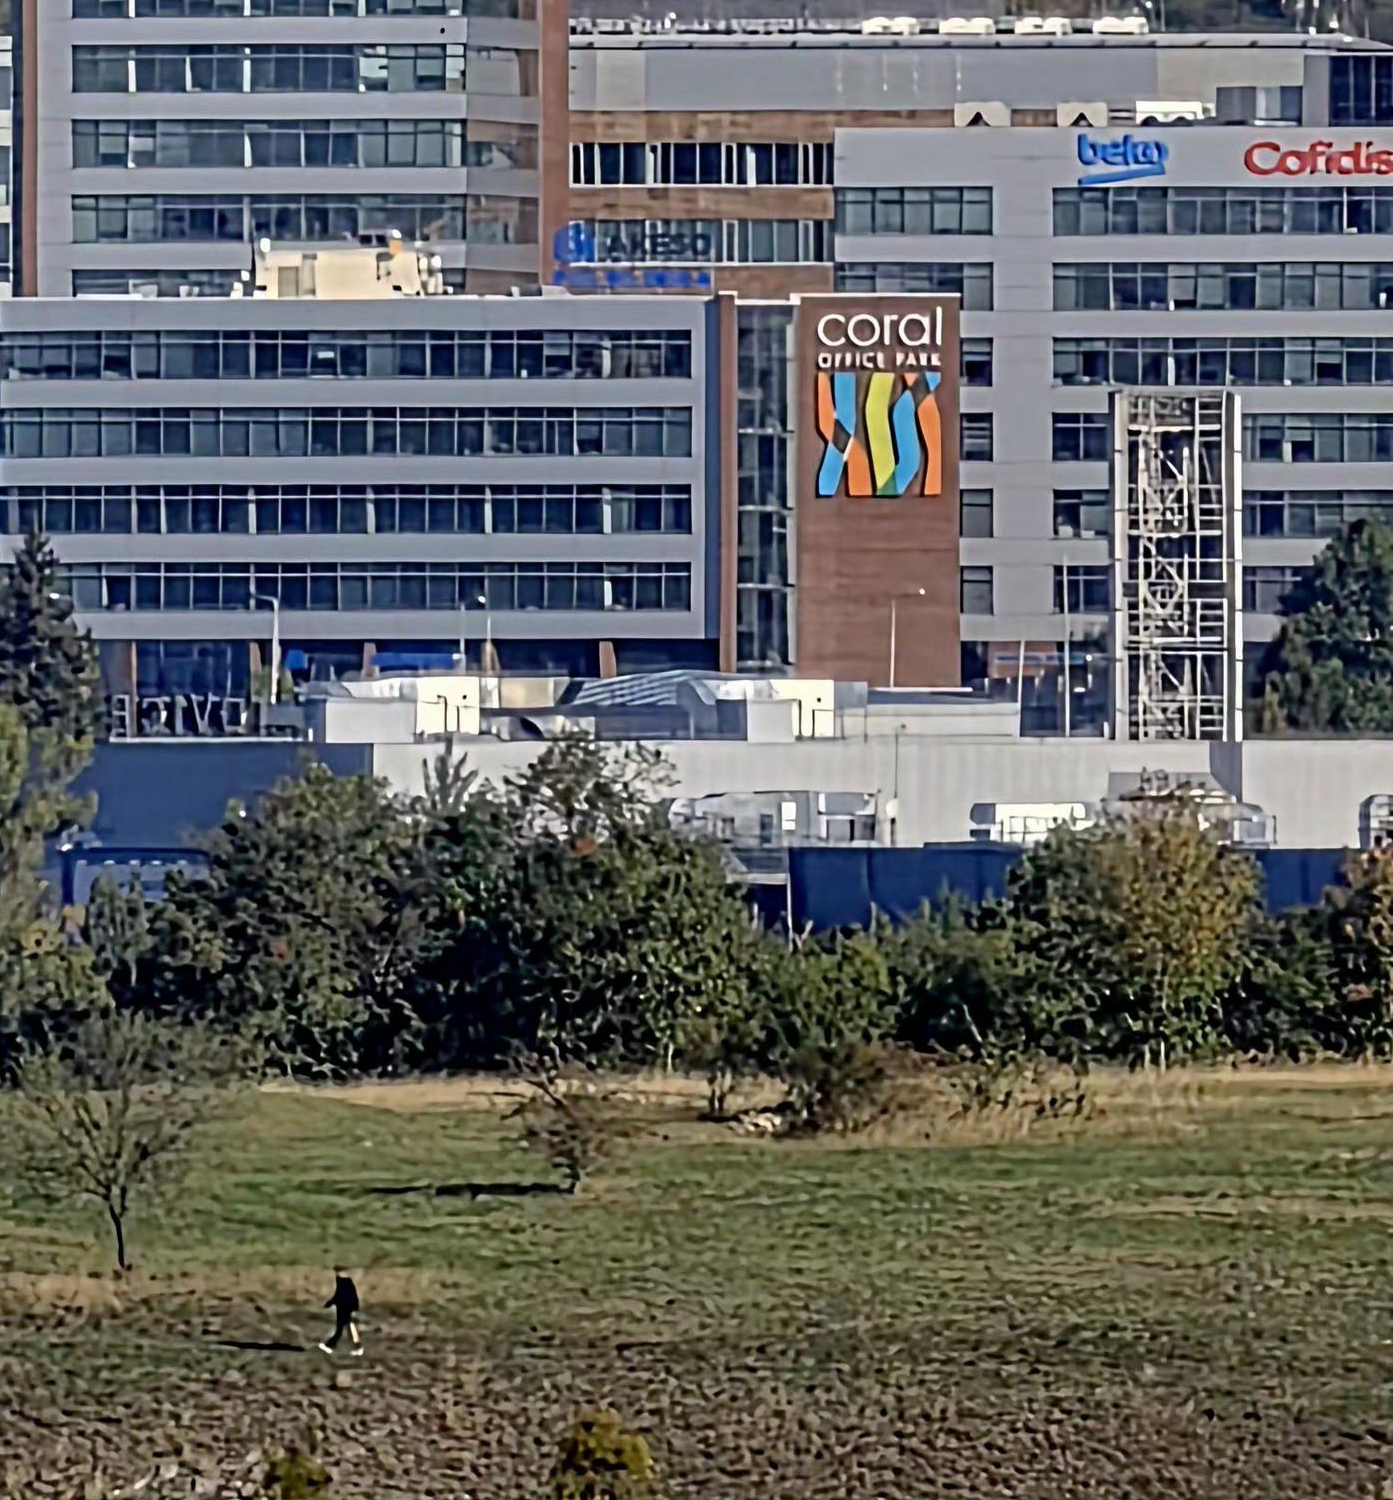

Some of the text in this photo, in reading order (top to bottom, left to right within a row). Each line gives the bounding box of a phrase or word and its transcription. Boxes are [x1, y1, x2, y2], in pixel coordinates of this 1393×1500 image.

[1244, 140, 1393, 175] Cofidis
[817, 306, 943, 346] coral
[818, 352, 942, 369] OFFICE PARK
